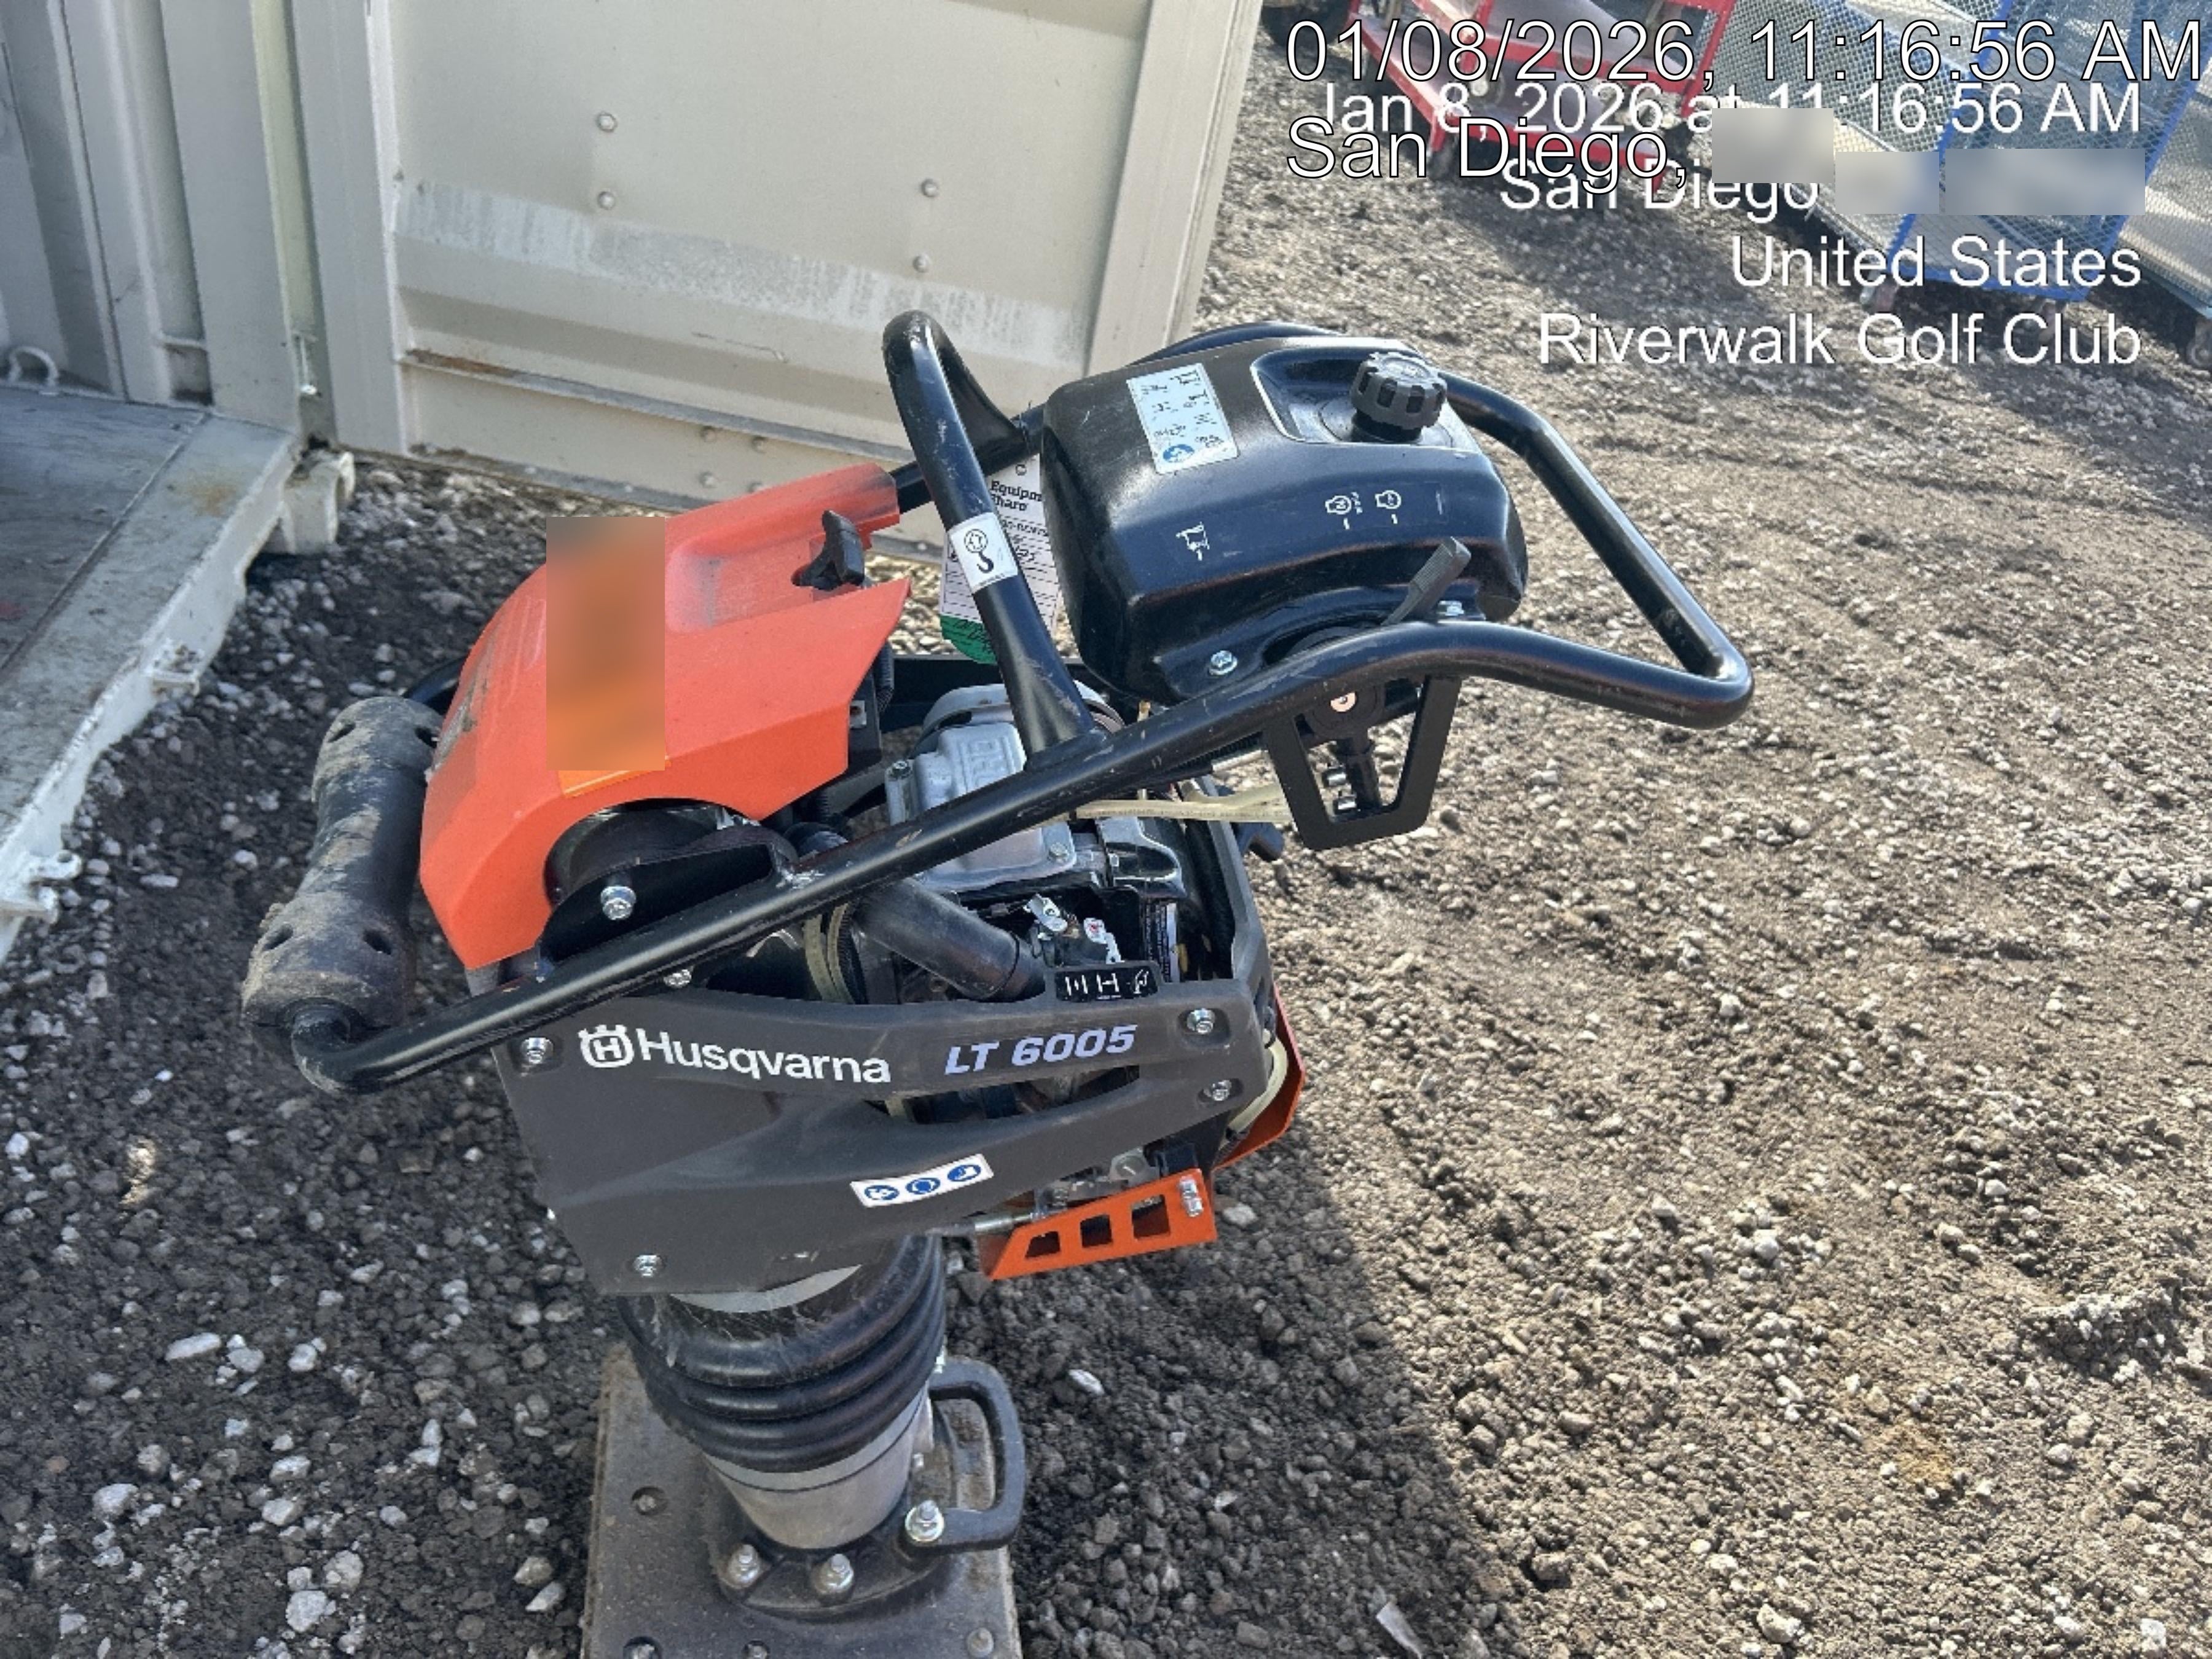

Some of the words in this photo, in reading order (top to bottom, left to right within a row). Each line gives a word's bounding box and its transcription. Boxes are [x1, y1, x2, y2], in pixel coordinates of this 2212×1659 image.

[635, 1028, 892, 1083] Husqvarna
[944, 1040, 1000, 1075] LT
[1011, 1024, 1139, 1067] 6005
